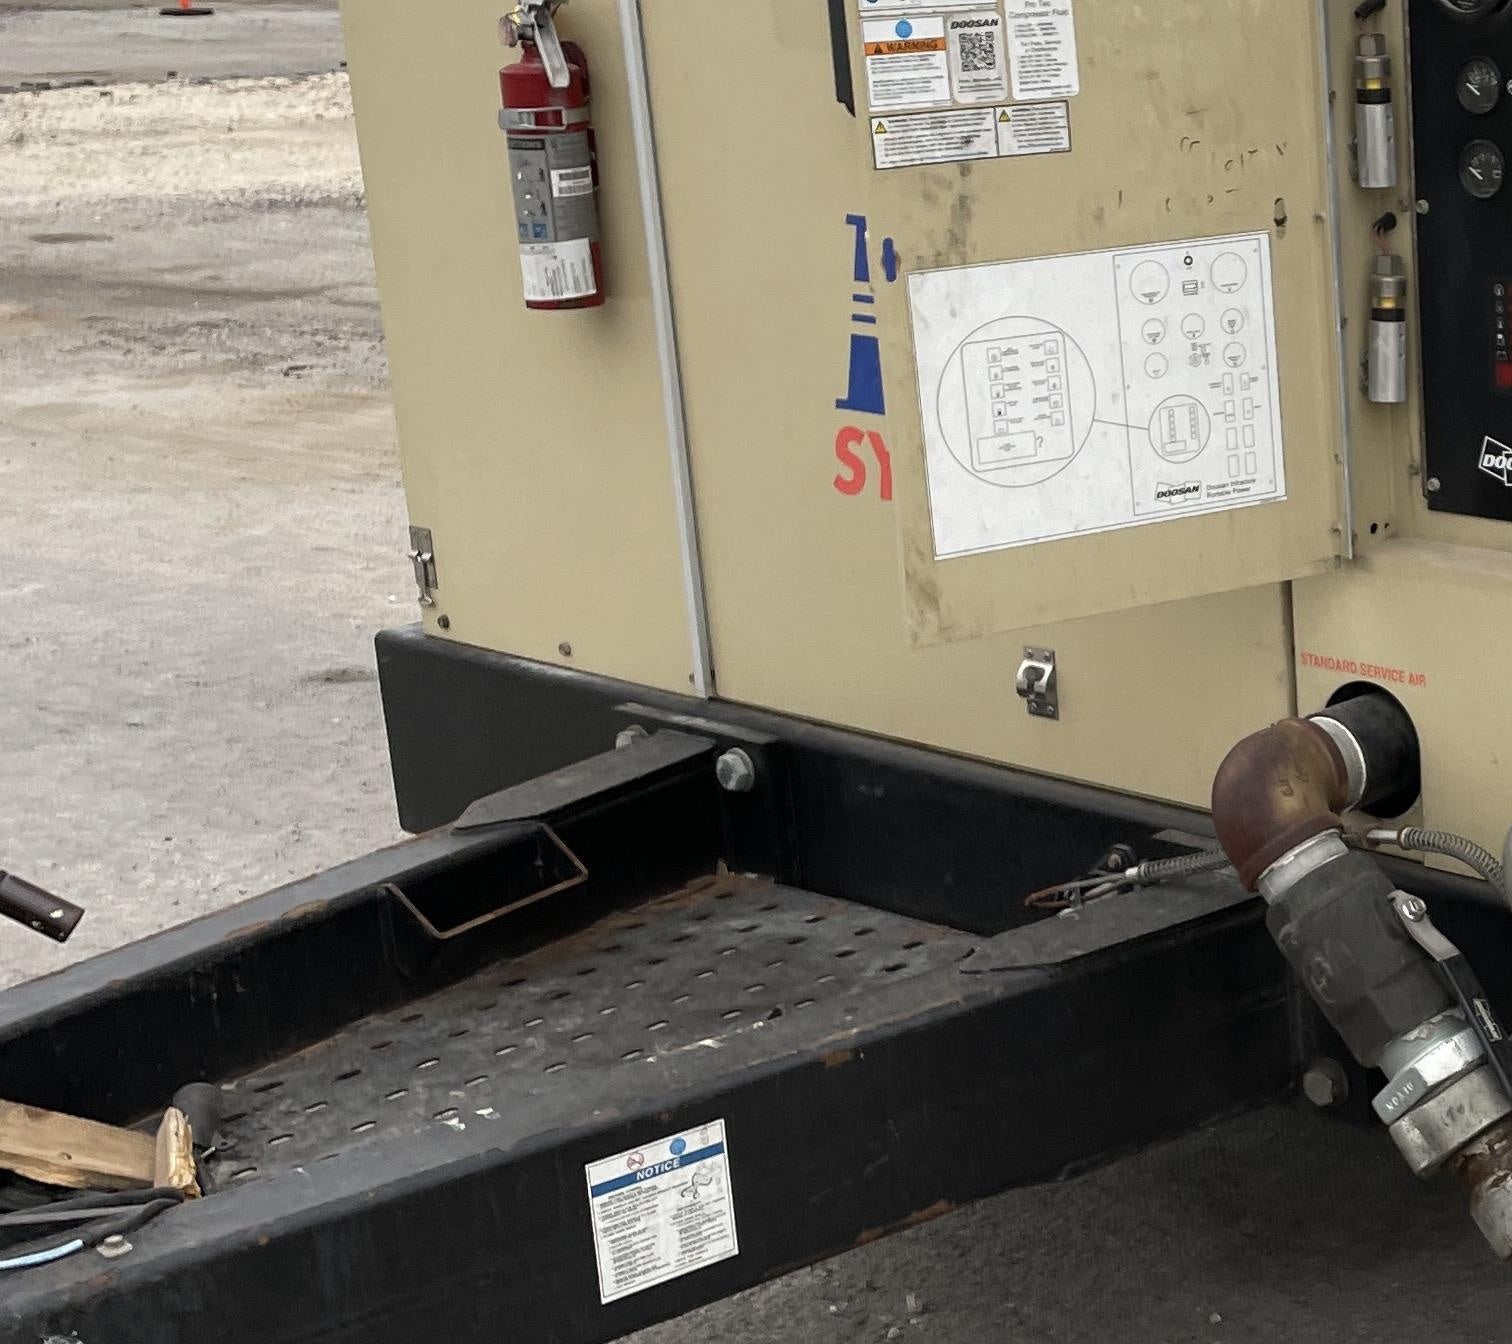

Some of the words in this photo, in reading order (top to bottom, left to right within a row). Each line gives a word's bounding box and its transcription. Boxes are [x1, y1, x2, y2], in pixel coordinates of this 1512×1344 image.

[950, 19, 999, 30] DOOSAN
[887, 40, 938, 52] WARNING
[1157, 485, 1200, 499] DOOSAN
[1301, 652, 1357, 674] STANDARD
[1360, 662, 1404, 683] SERVICE
[1408, 673, 1426, 686] AIR
[635, 1157, 681, 1181] NOTICE
